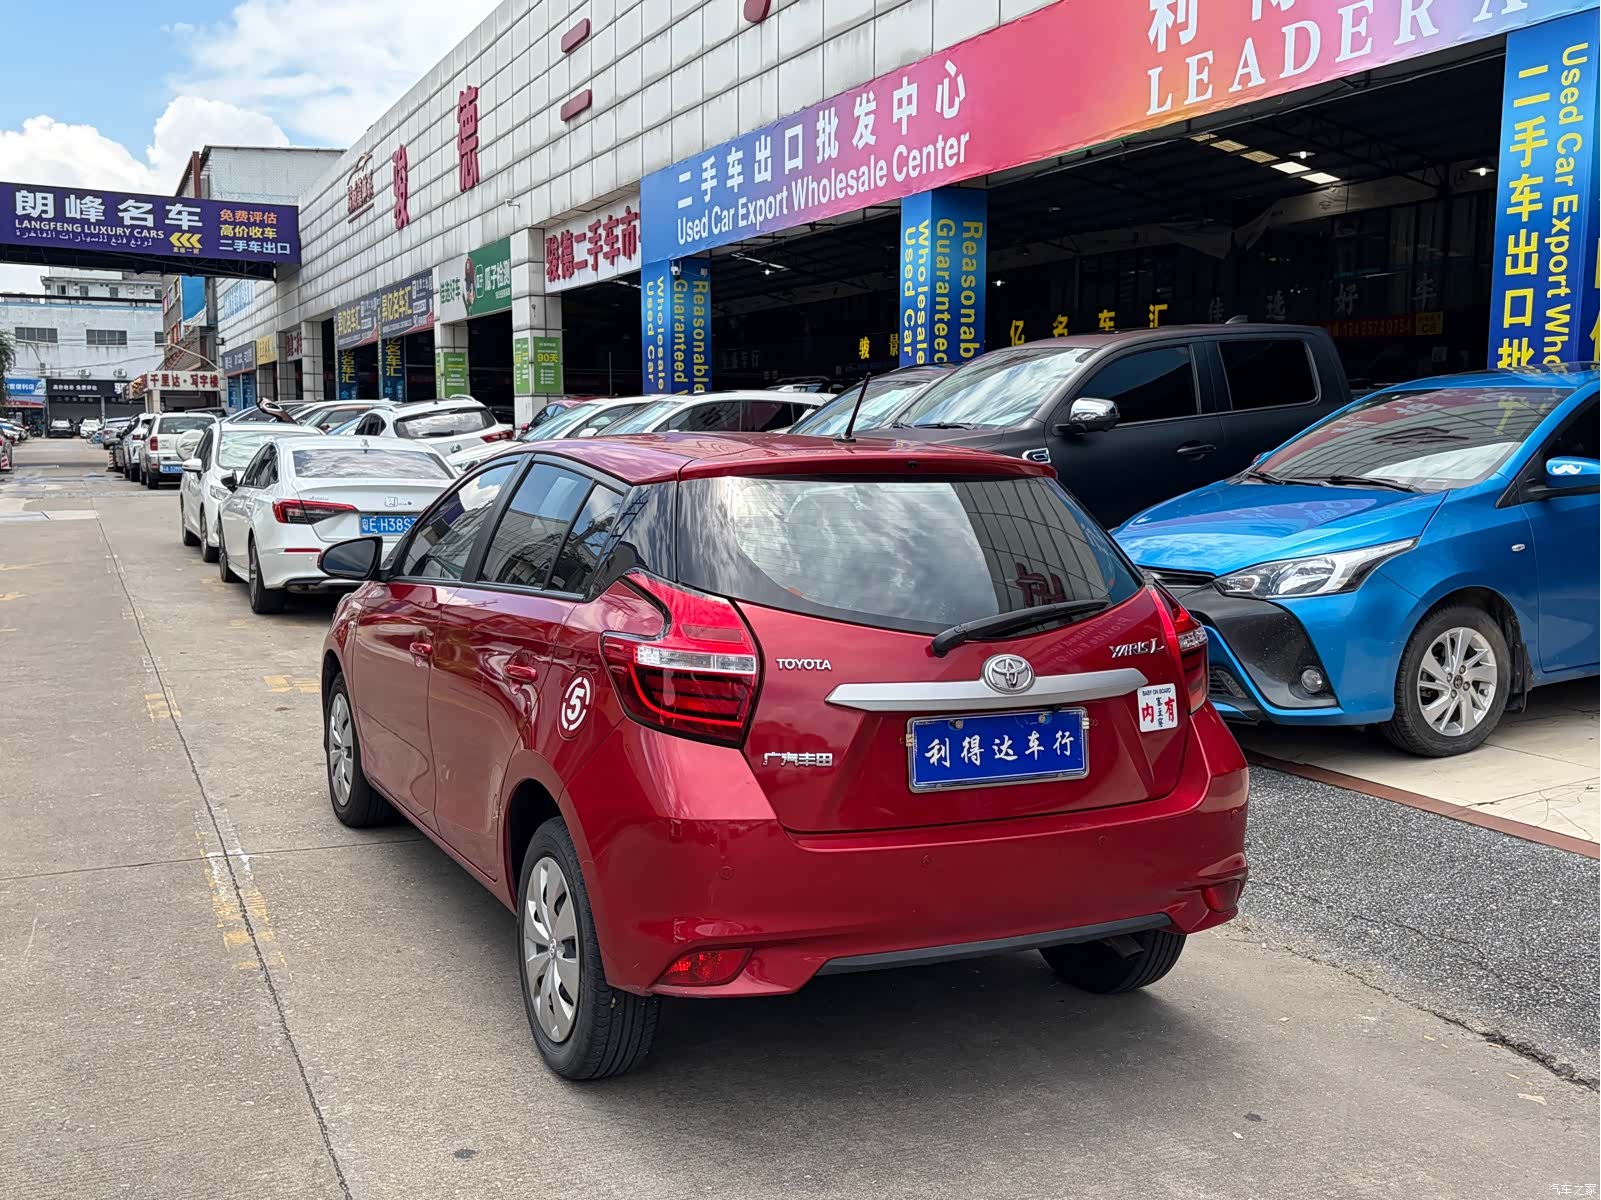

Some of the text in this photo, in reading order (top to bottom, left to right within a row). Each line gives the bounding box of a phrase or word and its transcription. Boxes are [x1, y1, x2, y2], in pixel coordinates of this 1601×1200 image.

[1145, 0, 1439, 115] LEADER
[1558, 42, 1589, 125] Used
[677, 60, 966, 209] 二手车出口批发中心
[1554, 132, 1583, 186] Car
[677, 130, 970, 245] Used Car Export Wholesale Center
[15, 190, 203, 231] 朗峰名车
[15, 219, 165, 239] LANGFENG LUXURY CARS
[219, 209, 278, 225] 免费评估
[218, 239, 291, 255] 二手车出口
[219, 224, 278, 239] 高价收车
[546, 205, 641, 283] 骏德二手车市
[1544, 194, 1579, 298] Export
[903, 226, 917, 357] Used Car
[916, 218, 930, 365] Wholesale
[673, 279, 689, 383] Guaranteed
[693, 280, 709, 392] Reasonable
[537, 353, 559, 363] 90天
[647, 345, 655, 382] Car
[776, 658, 832, 670] TOYOTA
[1109, 640, 1149, 658] YARIS
[565, 687, 586, 721] 5
[1141, 702, 1155, 724] 内
[1164, 696, 1175, 723] 有
[762, 751, 833, 767] 广汽丰田
[924, 729, 1075, 769] 利得达车行
